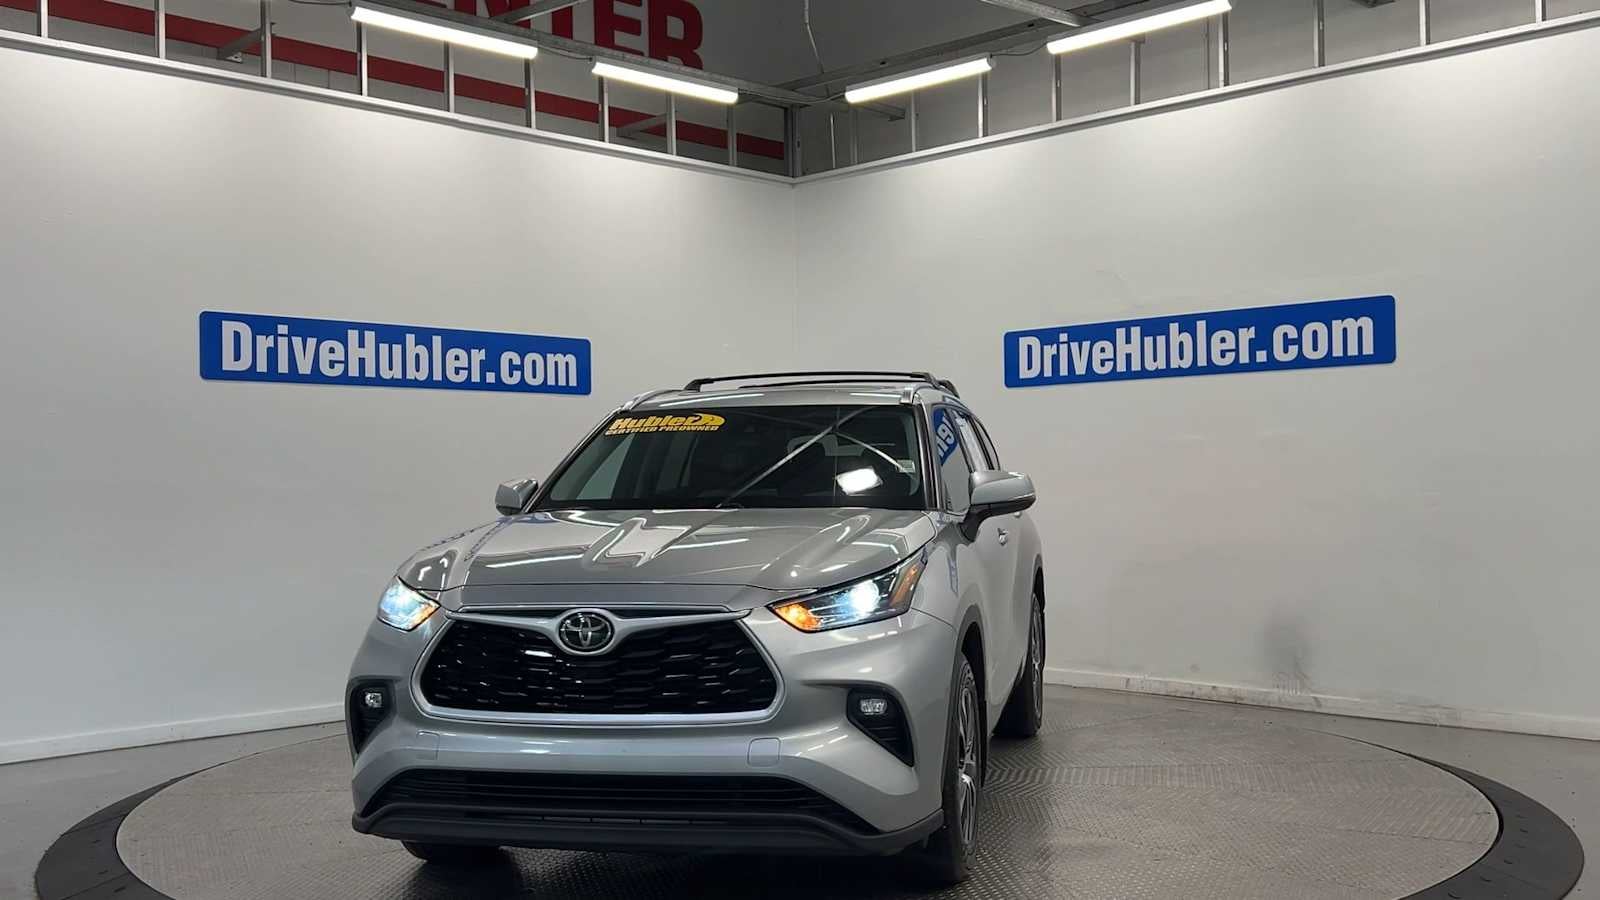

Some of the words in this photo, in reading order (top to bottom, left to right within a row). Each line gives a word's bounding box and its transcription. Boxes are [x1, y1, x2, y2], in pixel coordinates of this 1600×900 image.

[221, 319, 577, 387] DriveHubler.com
[1018, 316, 1374, 379] DriveHubler.com
[609, 415, 701, 430] Hubler
